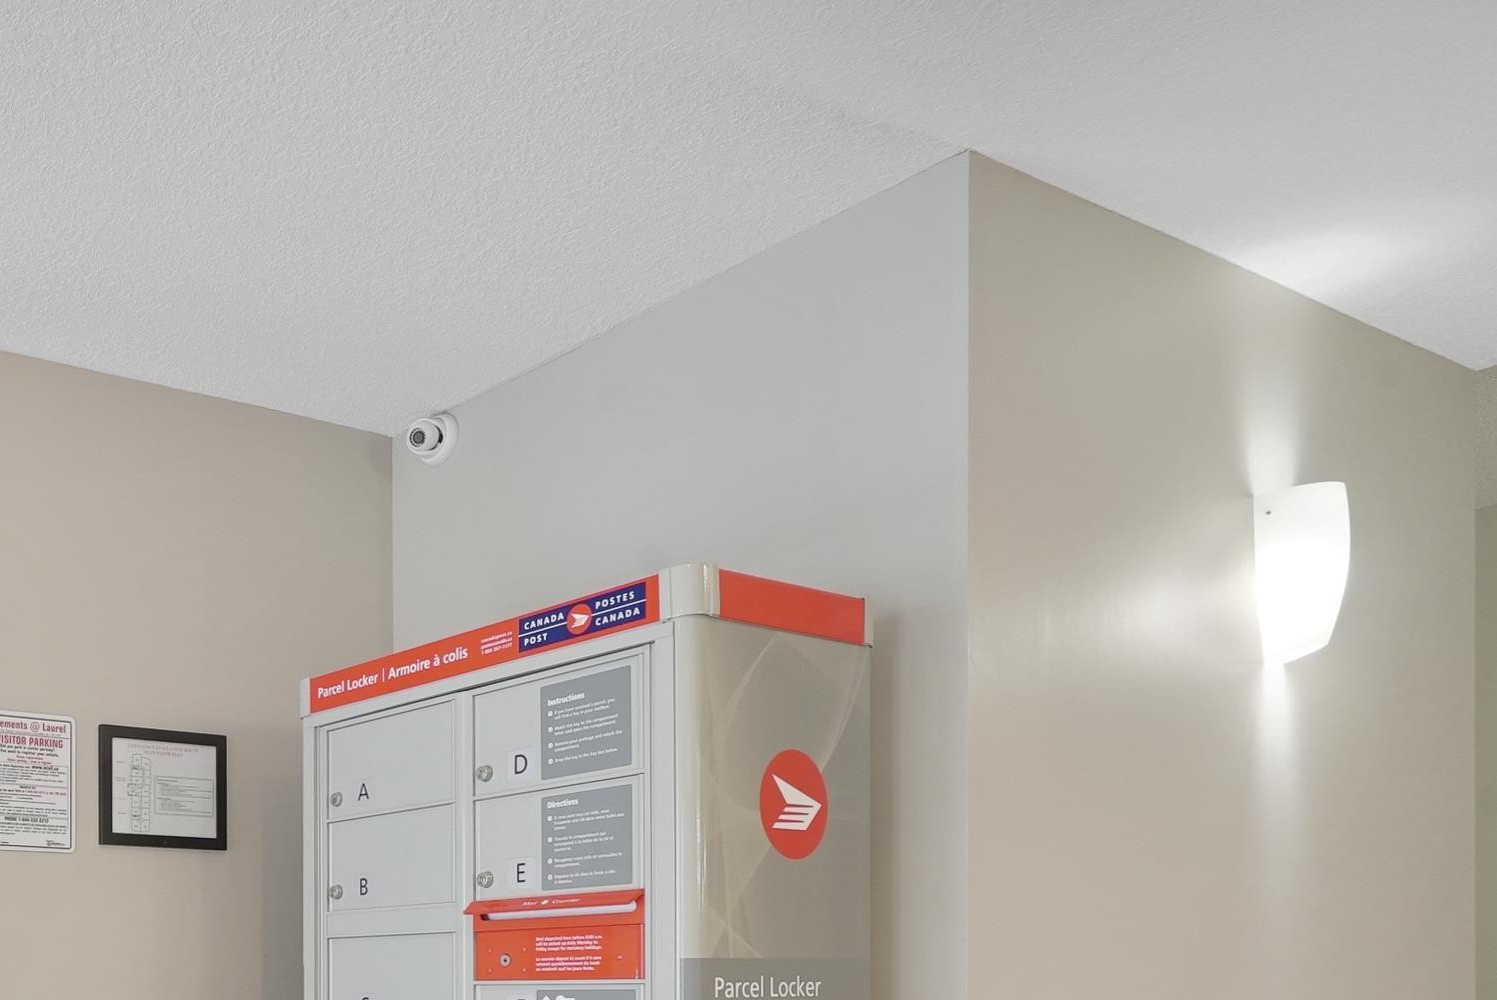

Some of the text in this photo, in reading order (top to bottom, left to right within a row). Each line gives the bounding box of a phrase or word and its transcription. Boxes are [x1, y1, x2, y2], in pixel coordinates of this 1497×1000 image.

[595, 591, 635, 609] POSTES
[524, 612, 565, 630] CANADA
[595, 607, 640, 626] CANADA
[524, 632, 548, 646] POST
[318, 647, 468, 699] Parcel Locker Armoire à colis
[548, 693, 585, 706] Instructions
[30, 721, 40, 733] @
[42, 722, 66, 733] Laurel
[29, 737, 64, 749] PARKING
[514, 754, 528, 775] D
[358, 783, 370, 801] A
[516, 863, 526, 883] E
[359, 878, 368, 896] B
[714, 976, 822, 998] Parcel Locker
